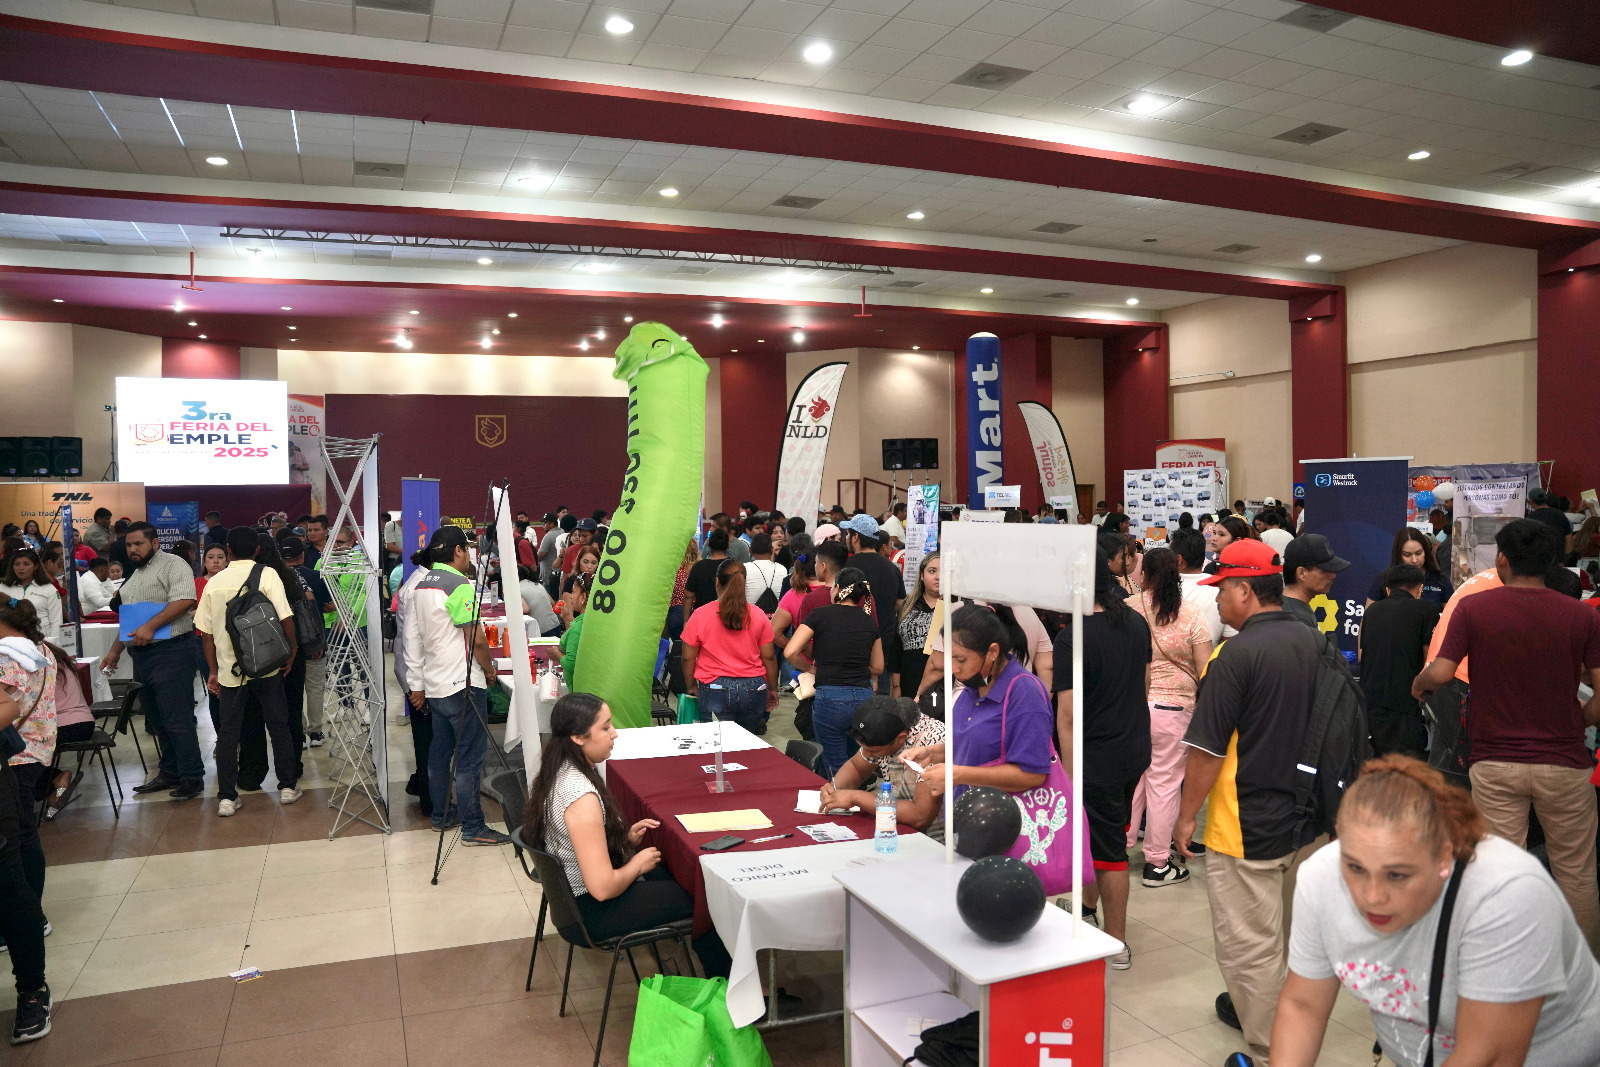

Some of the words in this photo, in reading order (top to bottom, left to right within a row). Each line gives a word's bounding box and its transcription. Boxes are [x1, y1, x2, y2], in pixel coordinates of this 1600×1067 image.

[181, 400, 232, 421] 3ra
[792, 405, 807, 423] I
[298, 415, 319, 424] DEL
[169, 422, 230, 432] FERIA
[236, 423, 274, 432] DEL
[786, 425, 828, 438] NLD
[169, 433, 252, 445] EMPLE
[213, 447, 269, 458] 2025
[52, 492, 94, 501] TNL
[592, 529, 627, 614] 800
[737, 864, 783, 872] DIESEL
